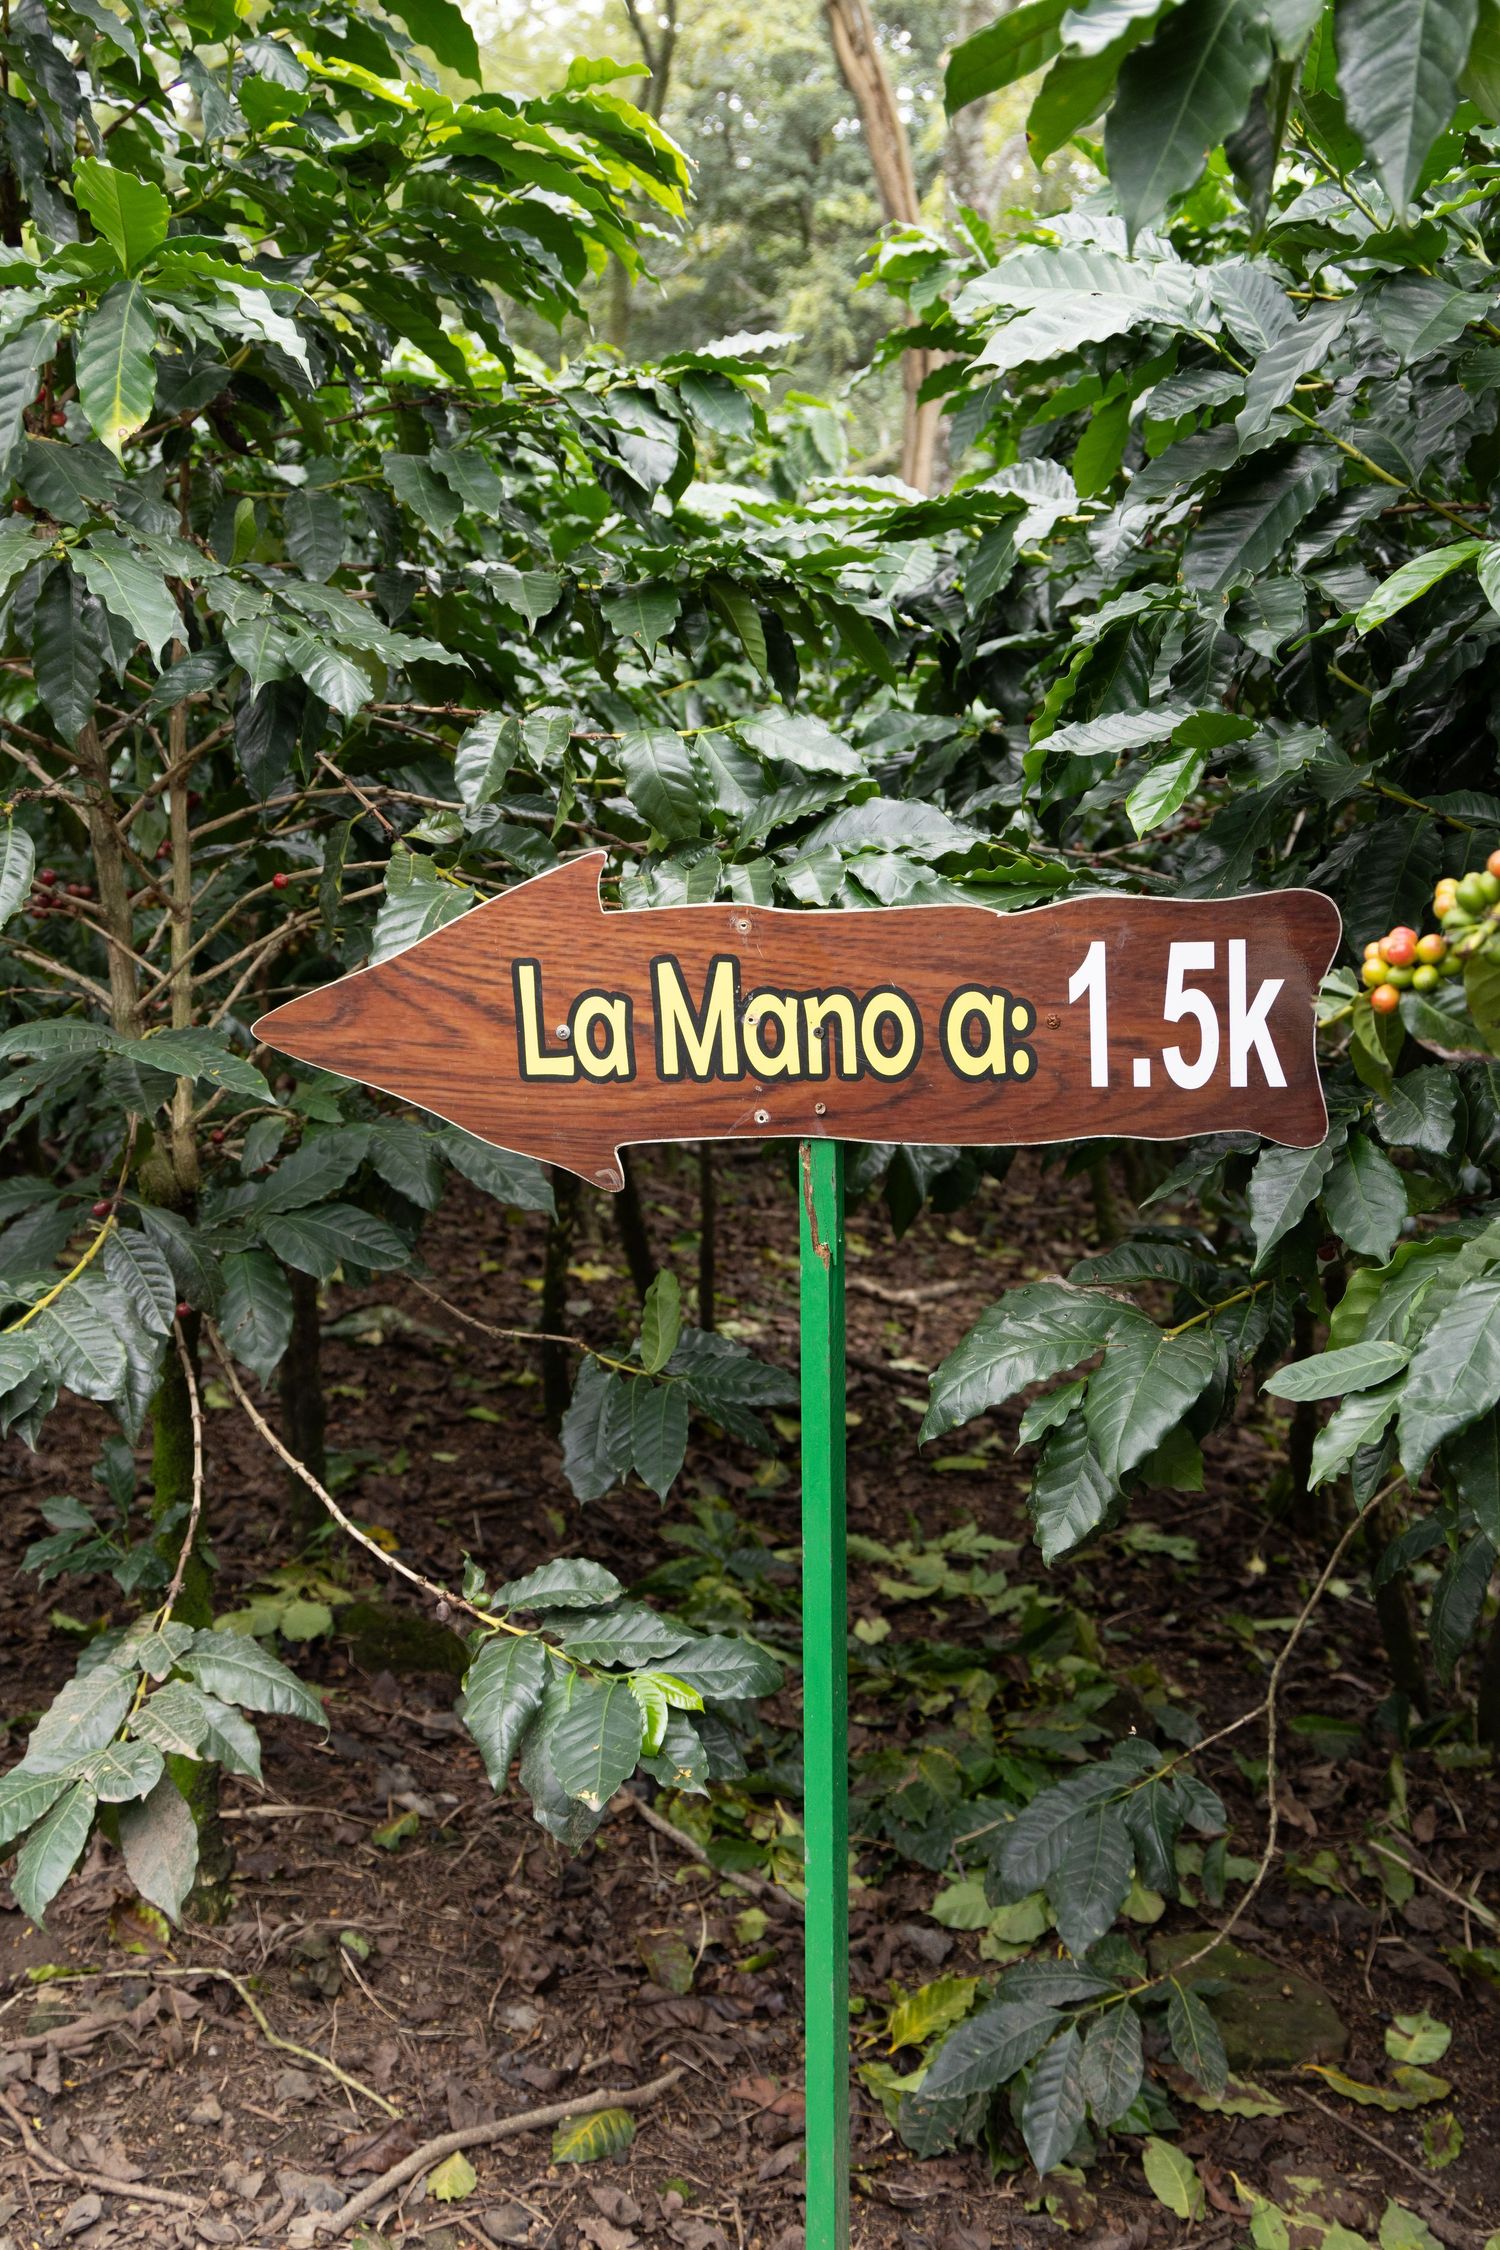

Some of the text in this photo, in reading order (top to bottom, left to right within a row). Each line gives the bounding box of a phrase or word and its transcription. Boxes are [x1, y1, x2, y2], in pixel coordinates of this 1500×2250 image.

[514, 938, 1288, 1090] La Mano a: 1.5k
